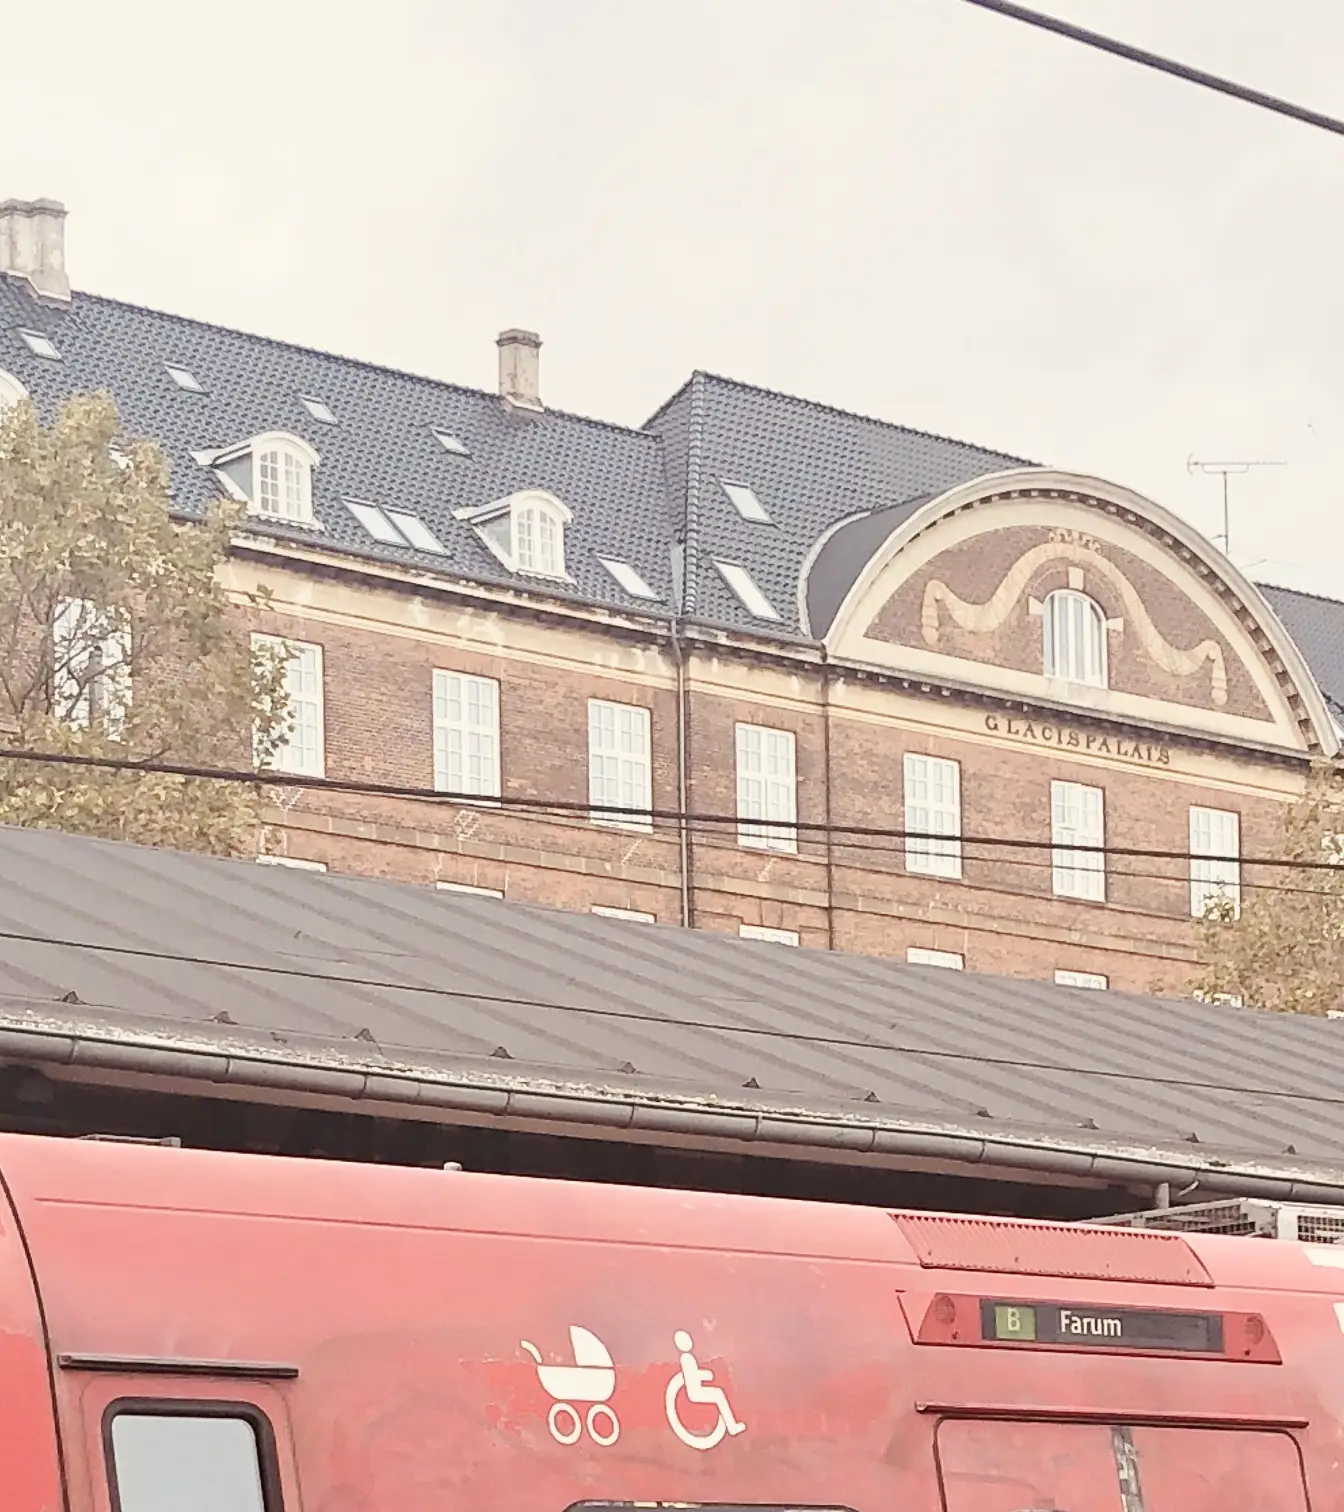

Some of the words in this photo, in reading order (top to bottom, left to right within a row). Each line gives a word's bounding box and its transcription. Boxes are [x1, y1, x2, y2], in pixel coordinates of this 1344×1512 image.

[984, 714, 1171, 765] GLACISPALAIS
[1006, 1307, 1022, 1332] B
[1061, 1310, 1122, 1337] Farum
